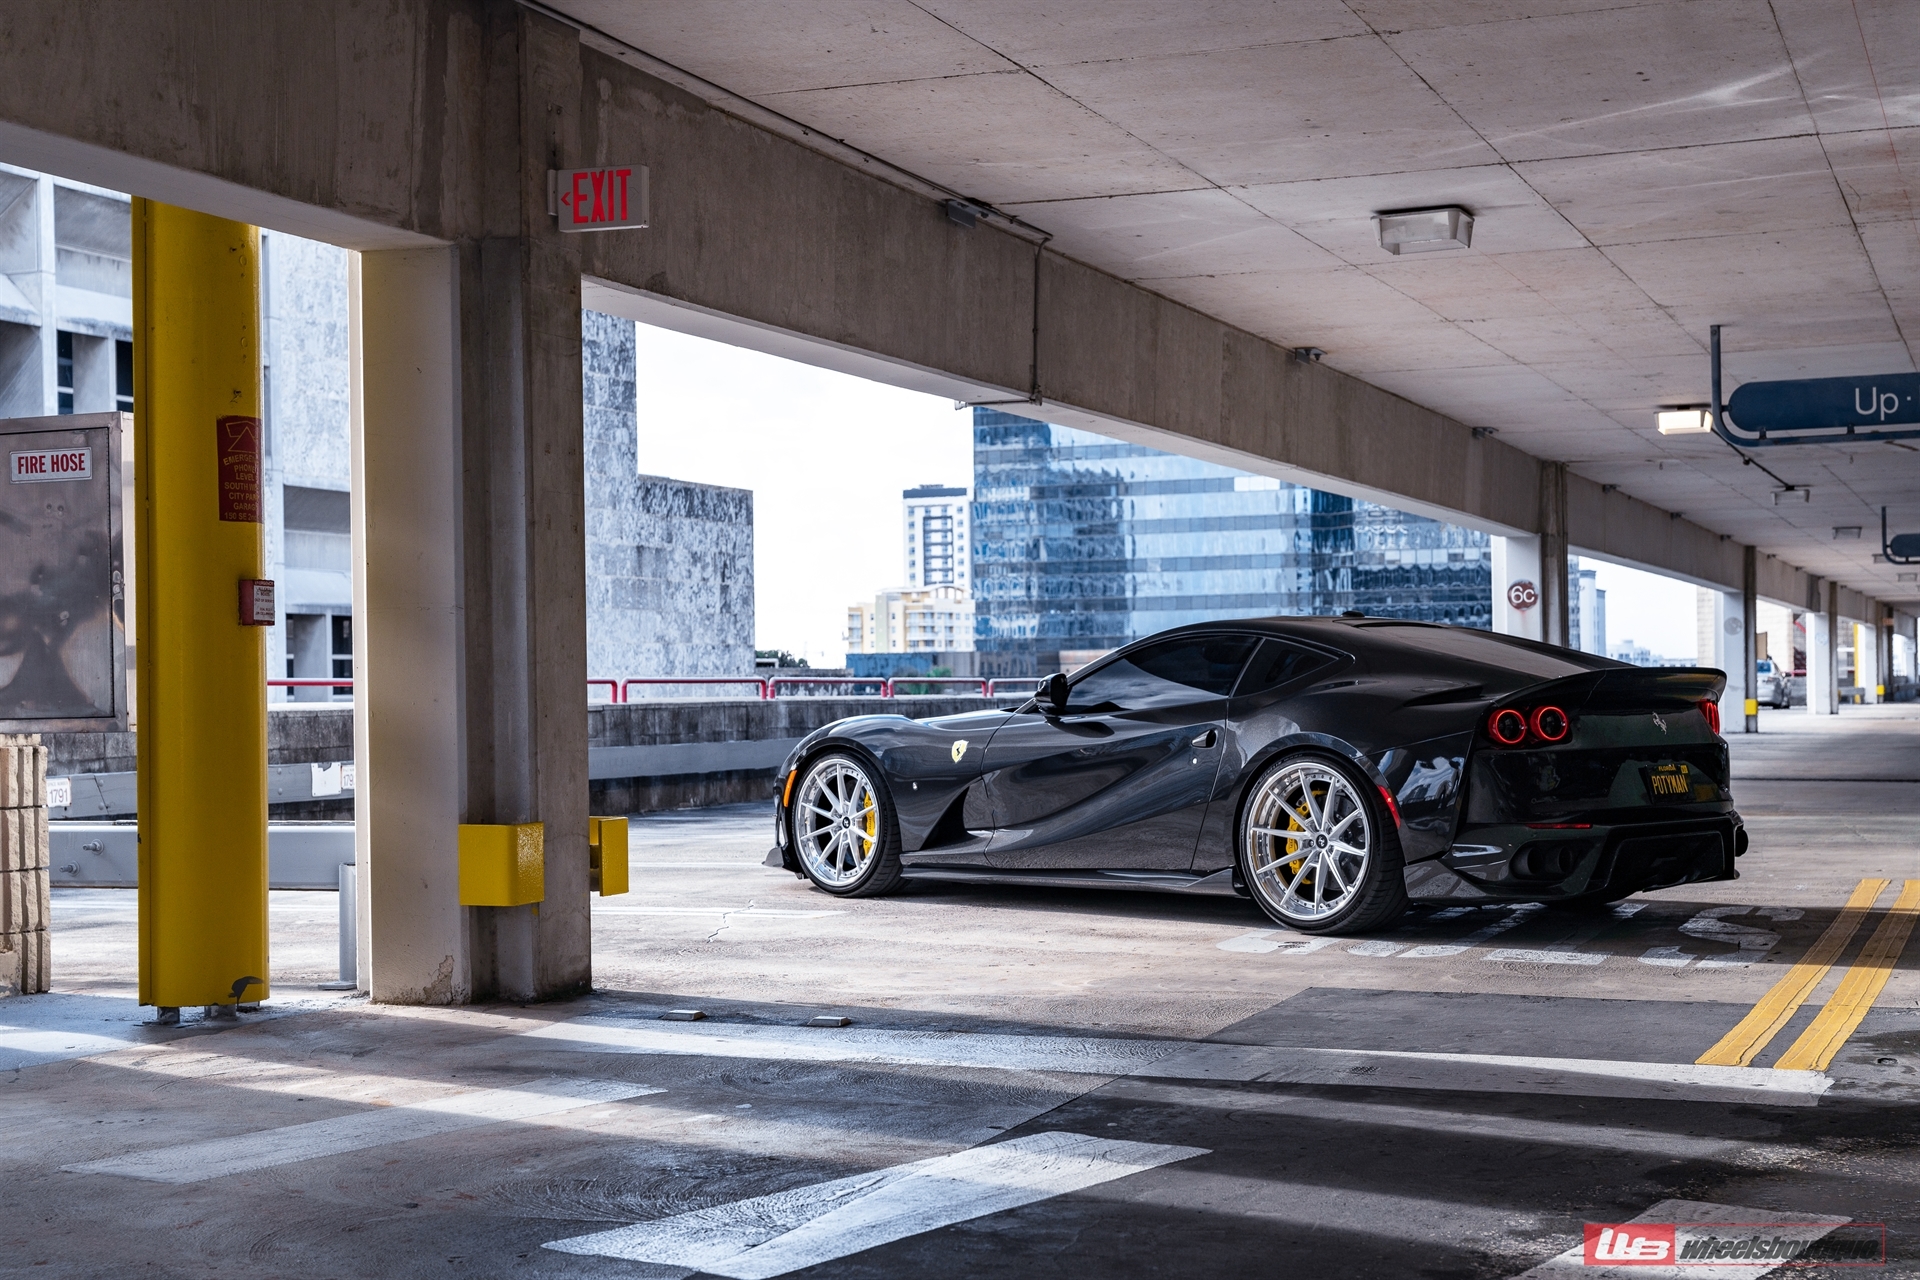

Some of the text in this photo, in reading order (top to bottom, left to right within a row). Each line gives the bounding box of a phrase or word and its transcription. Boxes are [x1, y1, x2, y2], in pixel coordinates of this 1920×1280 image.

[573, 169, 632, 224] EXIT
[1855, 387, 1899, 421] Up
[17, 453, 86, 475] FIRE HOSE
[235, 473, 255, 481] LEVEL
[224, 481, 249, 490] SOUTH
[228, 491, 245, 500] CITY
[224, 511, 237, 520] 150
[238, 512, 248, 521] SE
[1651, 775, 1688, 794] POTYMAN
[50, 788, 68, 803] 1791
